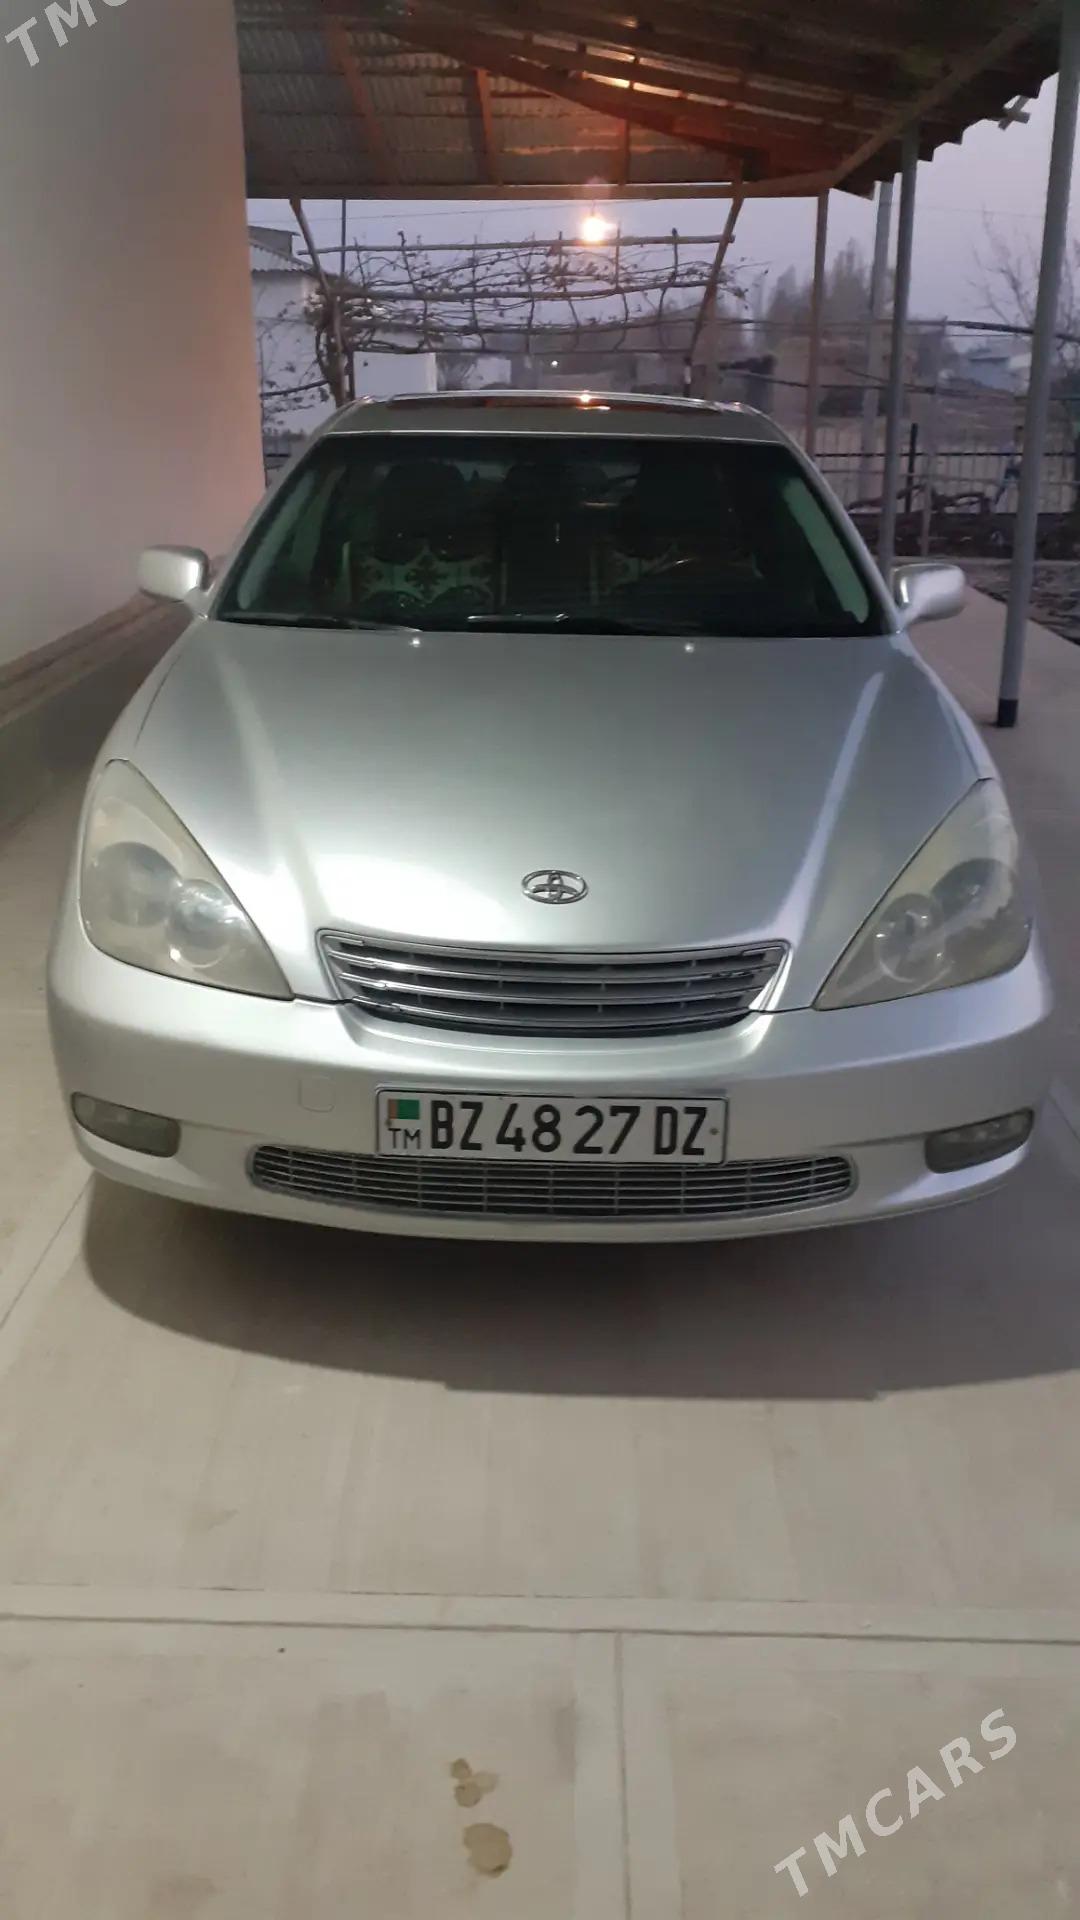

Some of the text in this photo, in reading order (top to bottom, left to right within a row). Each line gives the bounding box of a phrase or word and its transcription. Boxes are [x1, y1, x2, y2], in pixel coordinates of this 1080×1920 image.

[388, 1127, 421, 1149] TM
[430, 1100, 484, 1151] BZ
[654, 1106, 708, 1156] DZ
